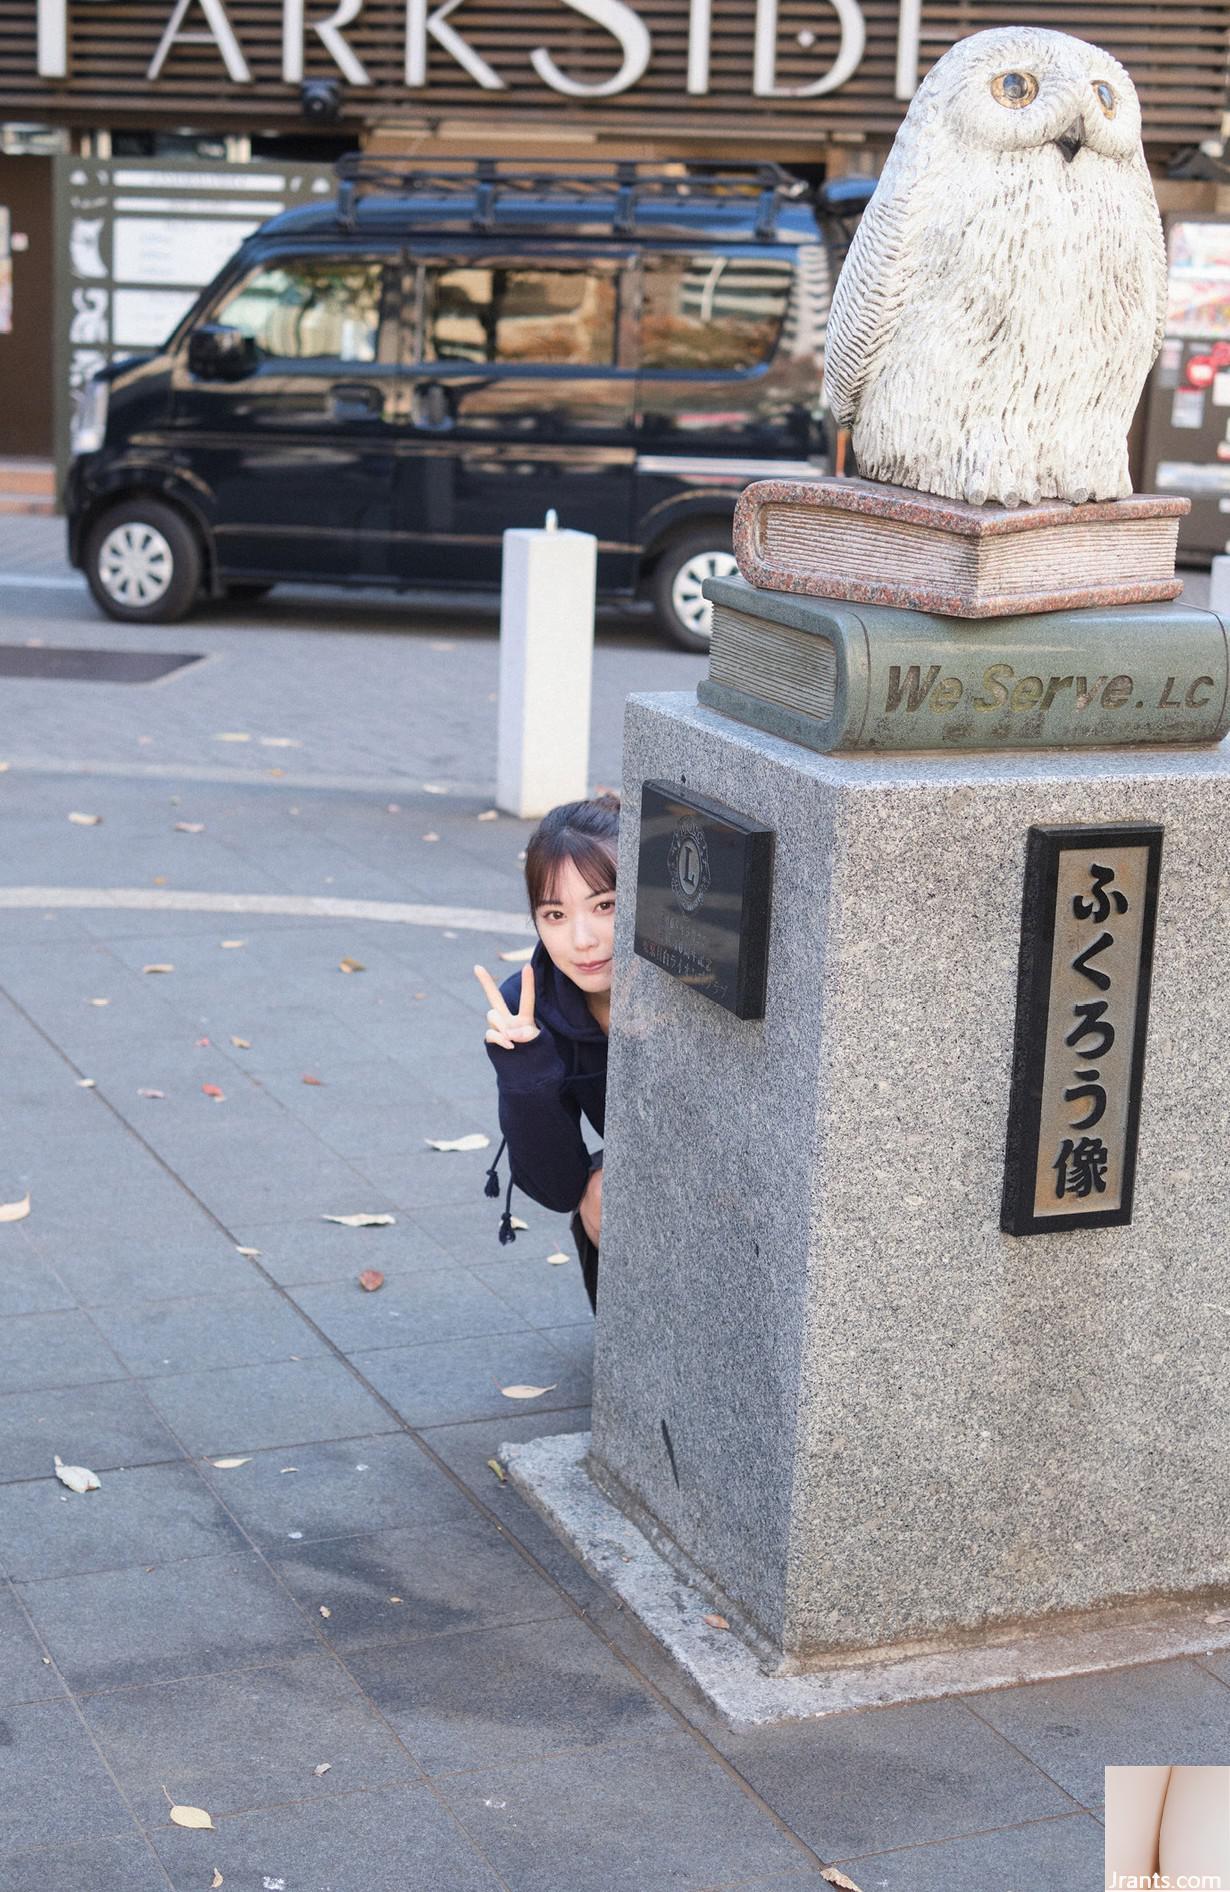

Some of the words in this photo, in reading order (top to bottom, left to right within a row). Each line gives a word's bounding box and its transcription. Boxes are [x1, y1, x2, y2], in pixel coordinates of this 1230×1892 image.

[885, 664, 964, 714] We
[972, 663, 1144, 714] Serve.
[1156, 675, 1215, 710] LC
[1051, 863, 1129, 1199] ふくろう像
